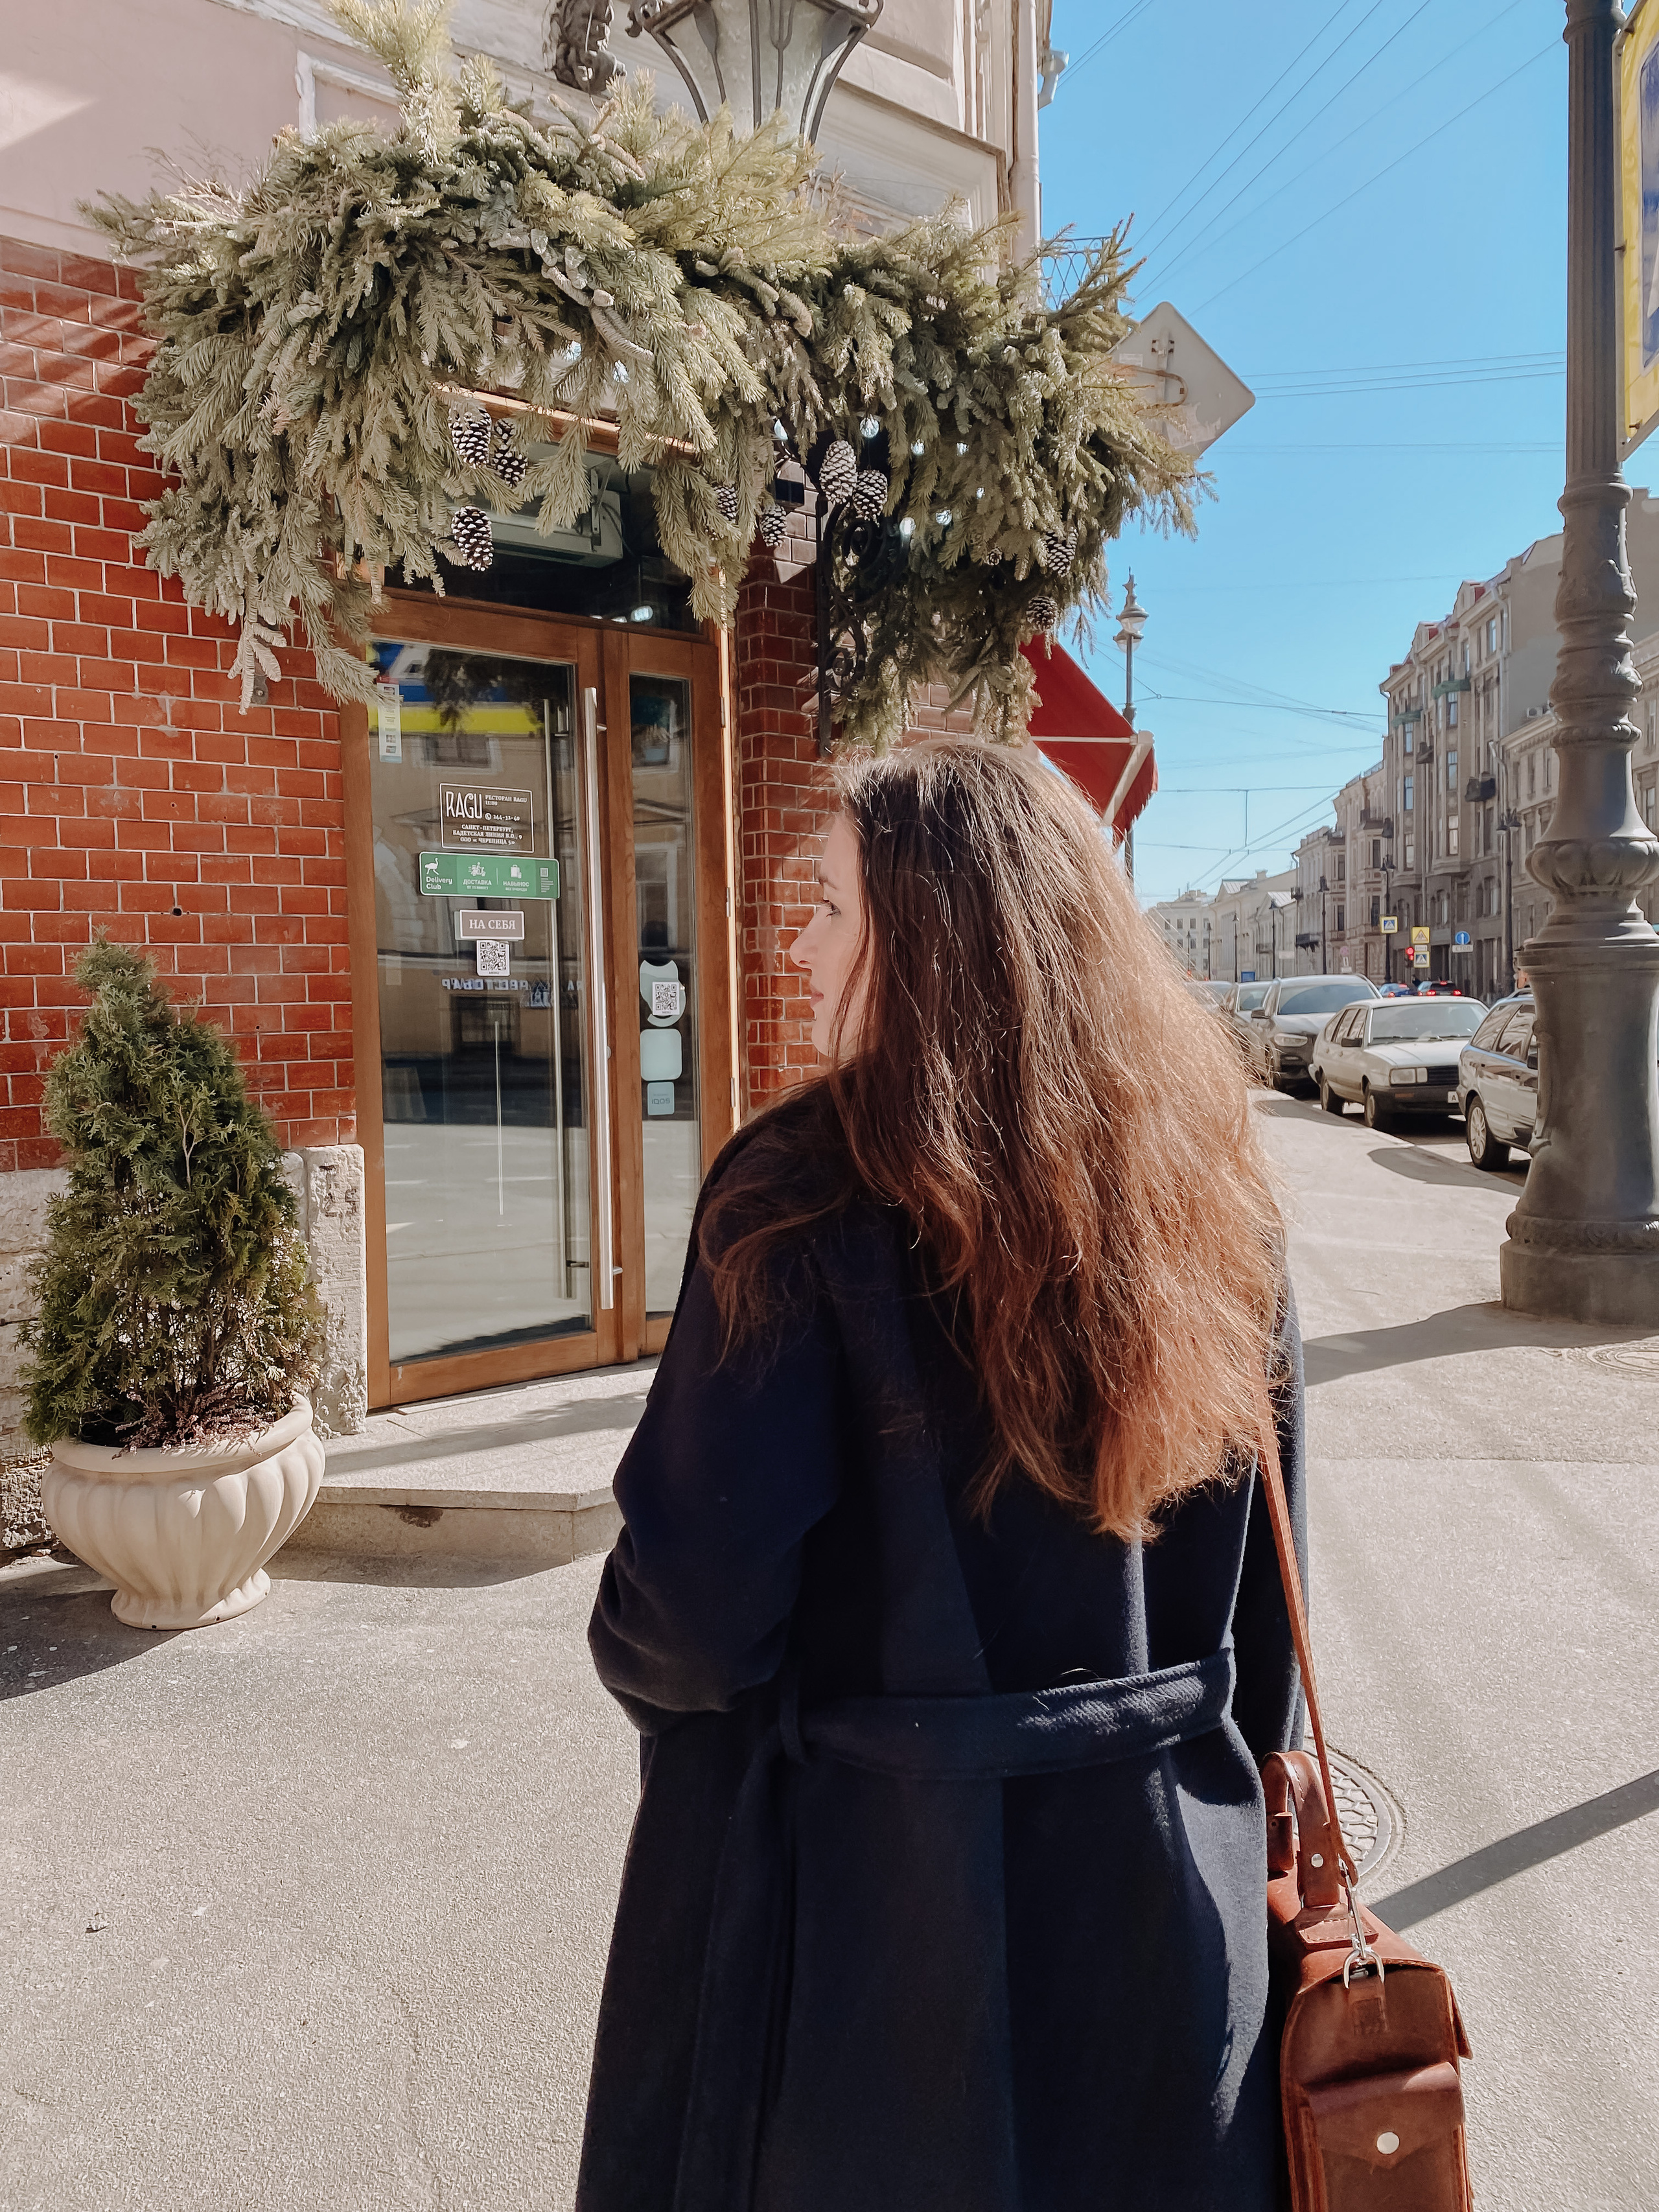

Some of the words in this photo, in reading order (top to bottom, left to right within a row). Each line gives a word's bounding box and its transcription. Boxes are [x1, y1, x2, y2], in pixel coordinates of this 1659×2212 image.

[446, 791, 483, 819] RAGU
[426, 876, 452, 885] Delivery
[469, 919, 486, 929] НА
[488, 920, 516, 929] СЕБЯ
